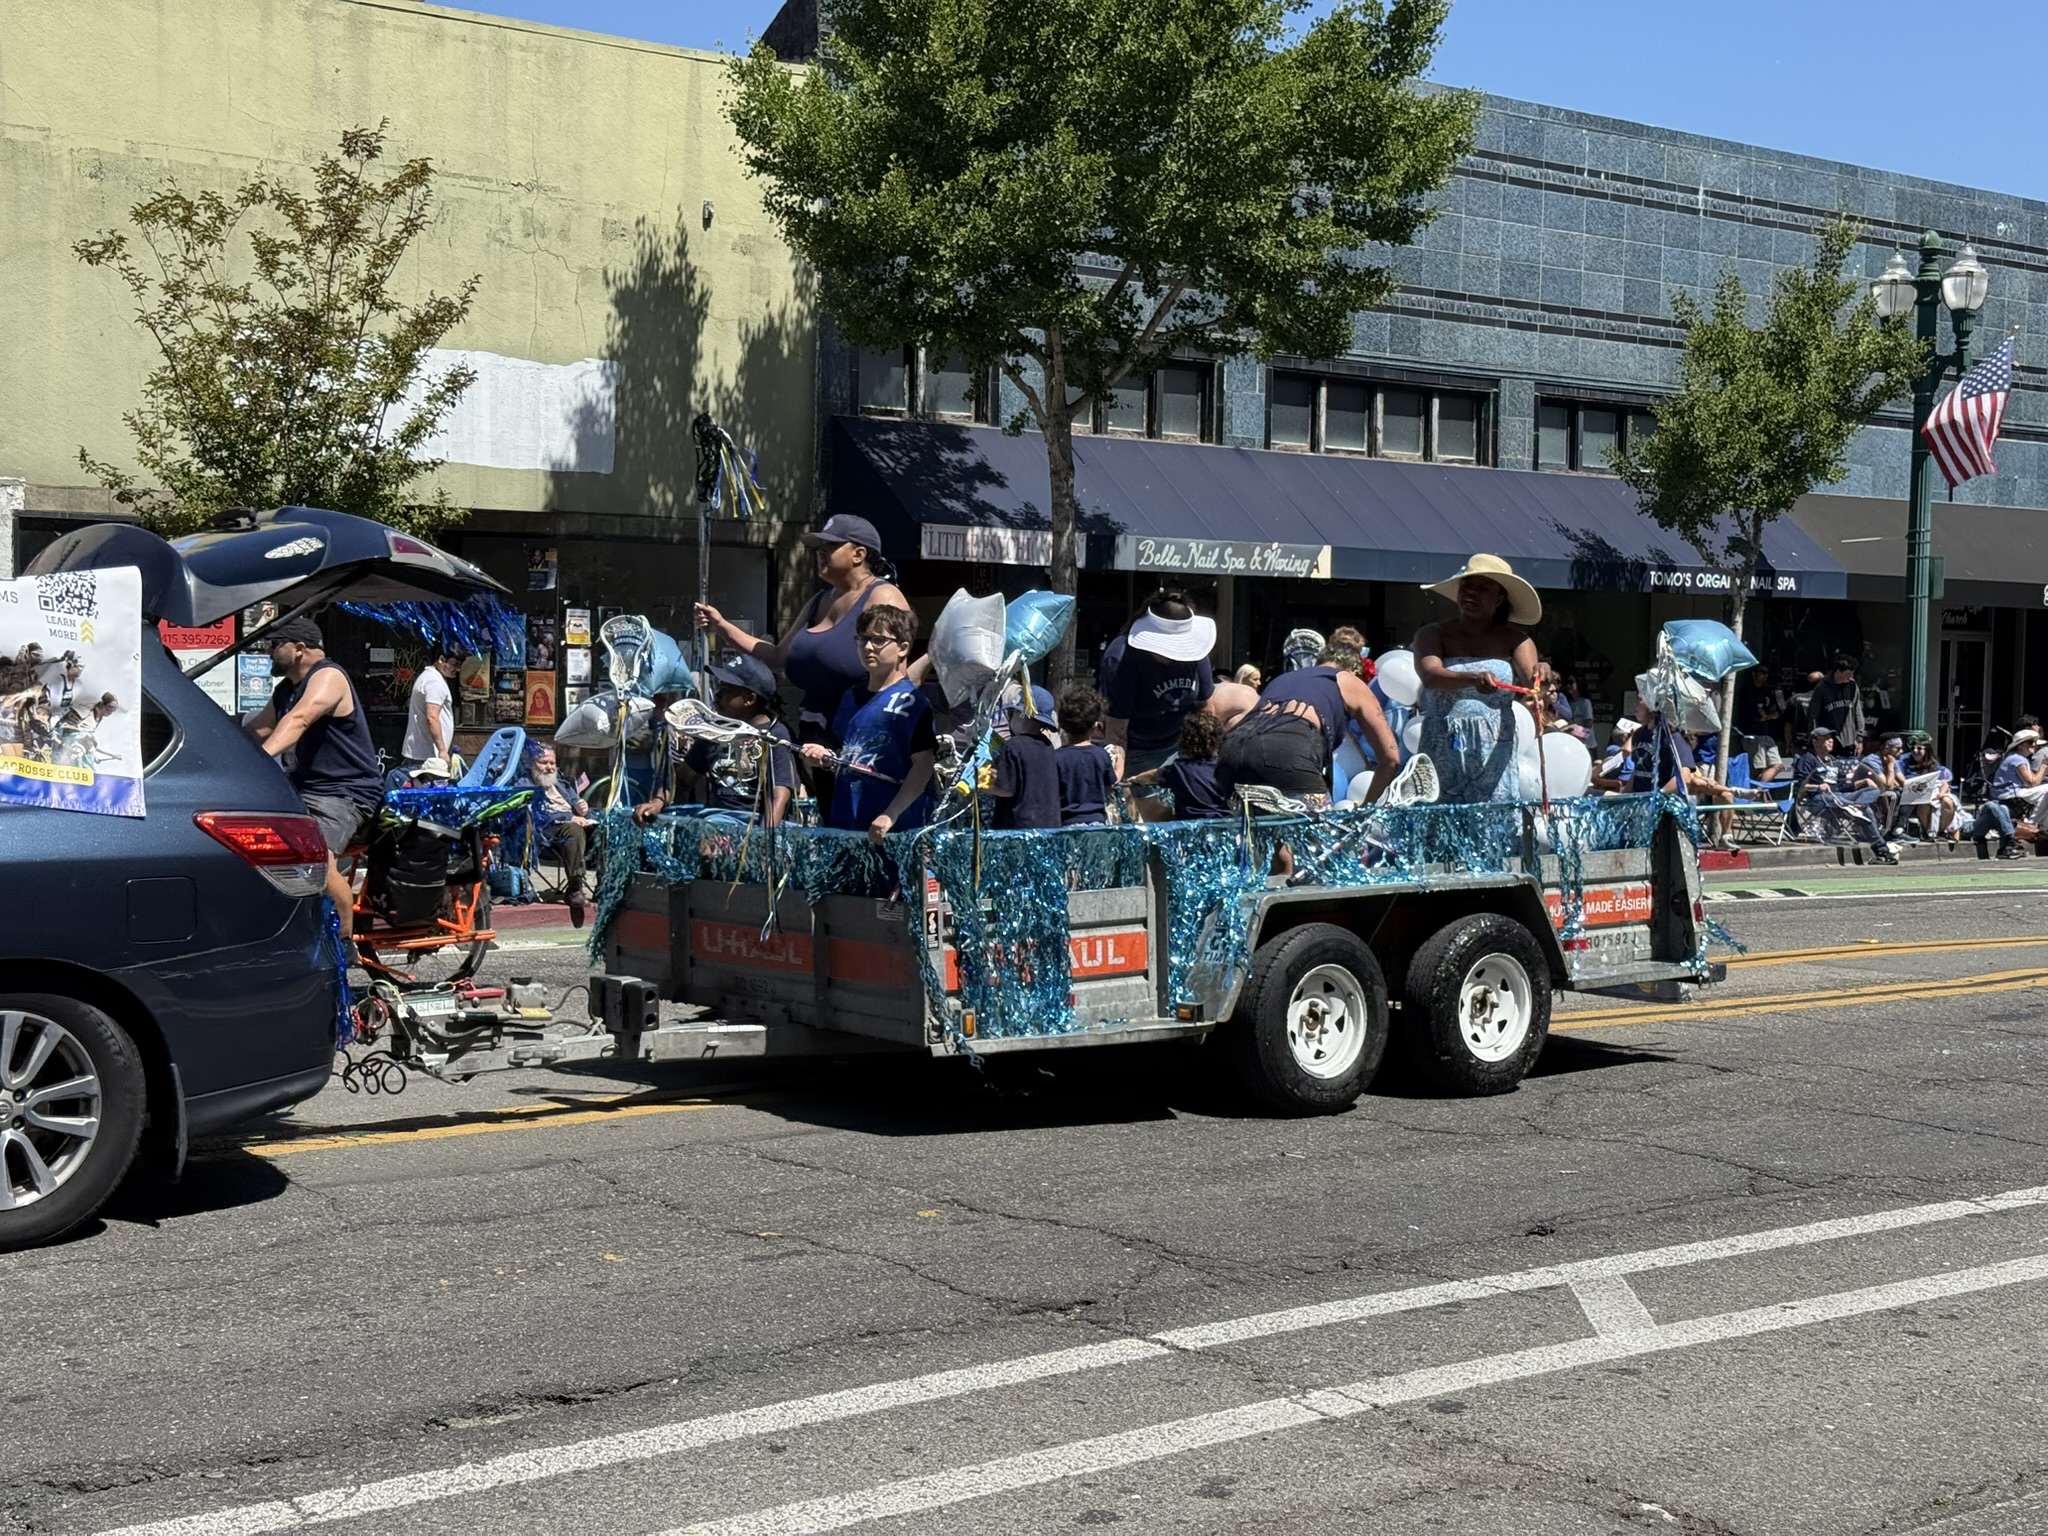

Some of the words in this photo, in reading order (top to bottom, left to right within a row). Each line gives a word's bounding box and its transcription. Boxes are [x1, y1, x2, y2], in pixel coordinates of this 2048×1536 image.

[928, 530, 977, 558] LITTLE
[1138, 539, 1182, 566] Bella
[1182, 542, 1218, 569] Nail
[1220, 547, 1246, 574] Spa
[1249, 546, 1262, 570] &
[1263, 547, 1311, 577] Waxing
[1650, 571, 1692, 587] TOMO'S
[1750, 576, 1773, 590] NAIL
[1777, 576, 1796, 591] SPA
[45, 615, 77, 628] LEARN
[49, 628, 78, 641] MORE!
[197, 680, 225, 688] tubner
[883, 692, 916, 718] 12
[58, 769, 89, 782] CLUB
[1586, 900, 1613, 914] MADE
[1615, 898, 1647, 911] EASIER
